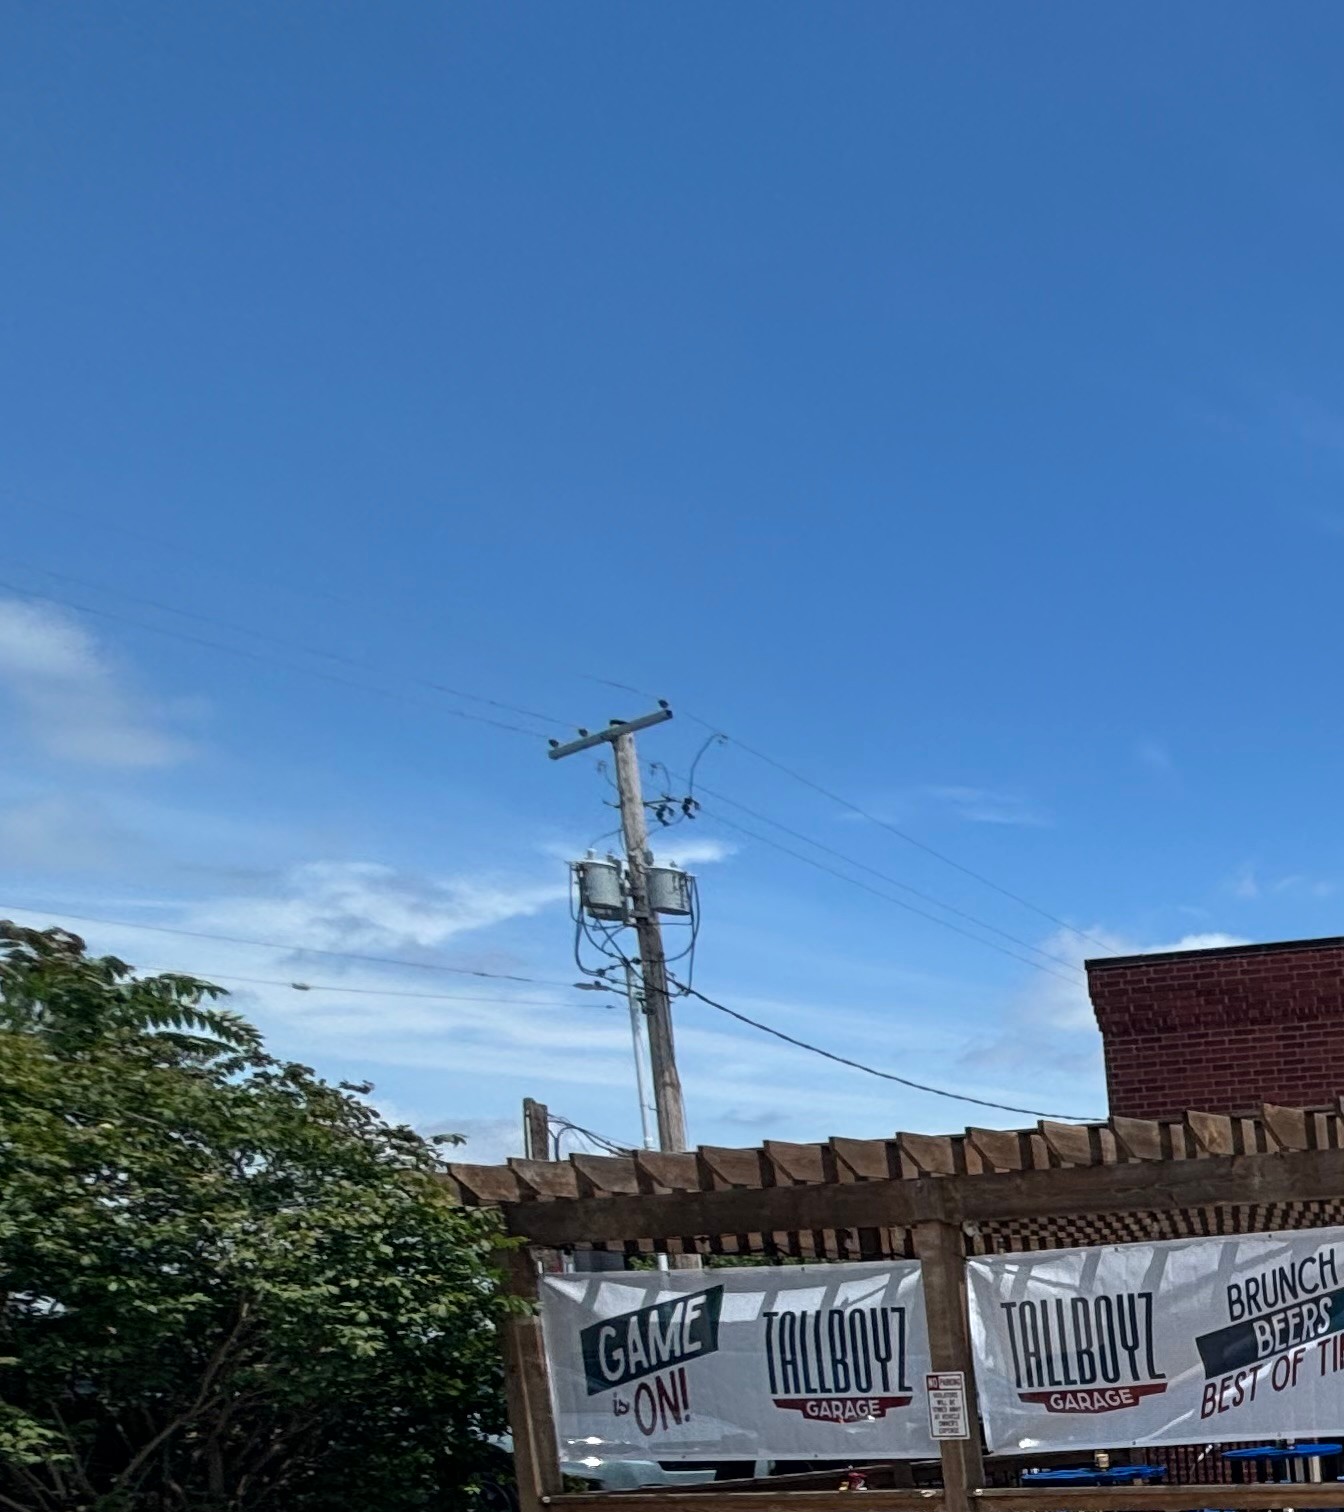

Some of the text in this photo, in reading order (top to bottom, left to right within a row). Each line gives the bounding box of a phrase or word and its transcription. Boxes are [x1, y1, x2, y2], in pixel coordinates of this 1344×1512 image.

[1227, 1248, 1338, 1322] BRUNCH
[598, 1294, 707, 1381] GAME
[762, 1307, 913, 1395] TALLBOYZ
[1000, 1292, 1166, 1388] TALLBOYZ
[1253, 1297, 1333, 1359] BEERS
[613, 1367, 691, 1437] is ON!
[806, 1399, 882, 1420] GARAGE
[1050, 1388, 1135, 1411] GARAGE
[1201, 1364, 1264, 1420] BEST
[1271, 1347, 1307, 1392] OF
